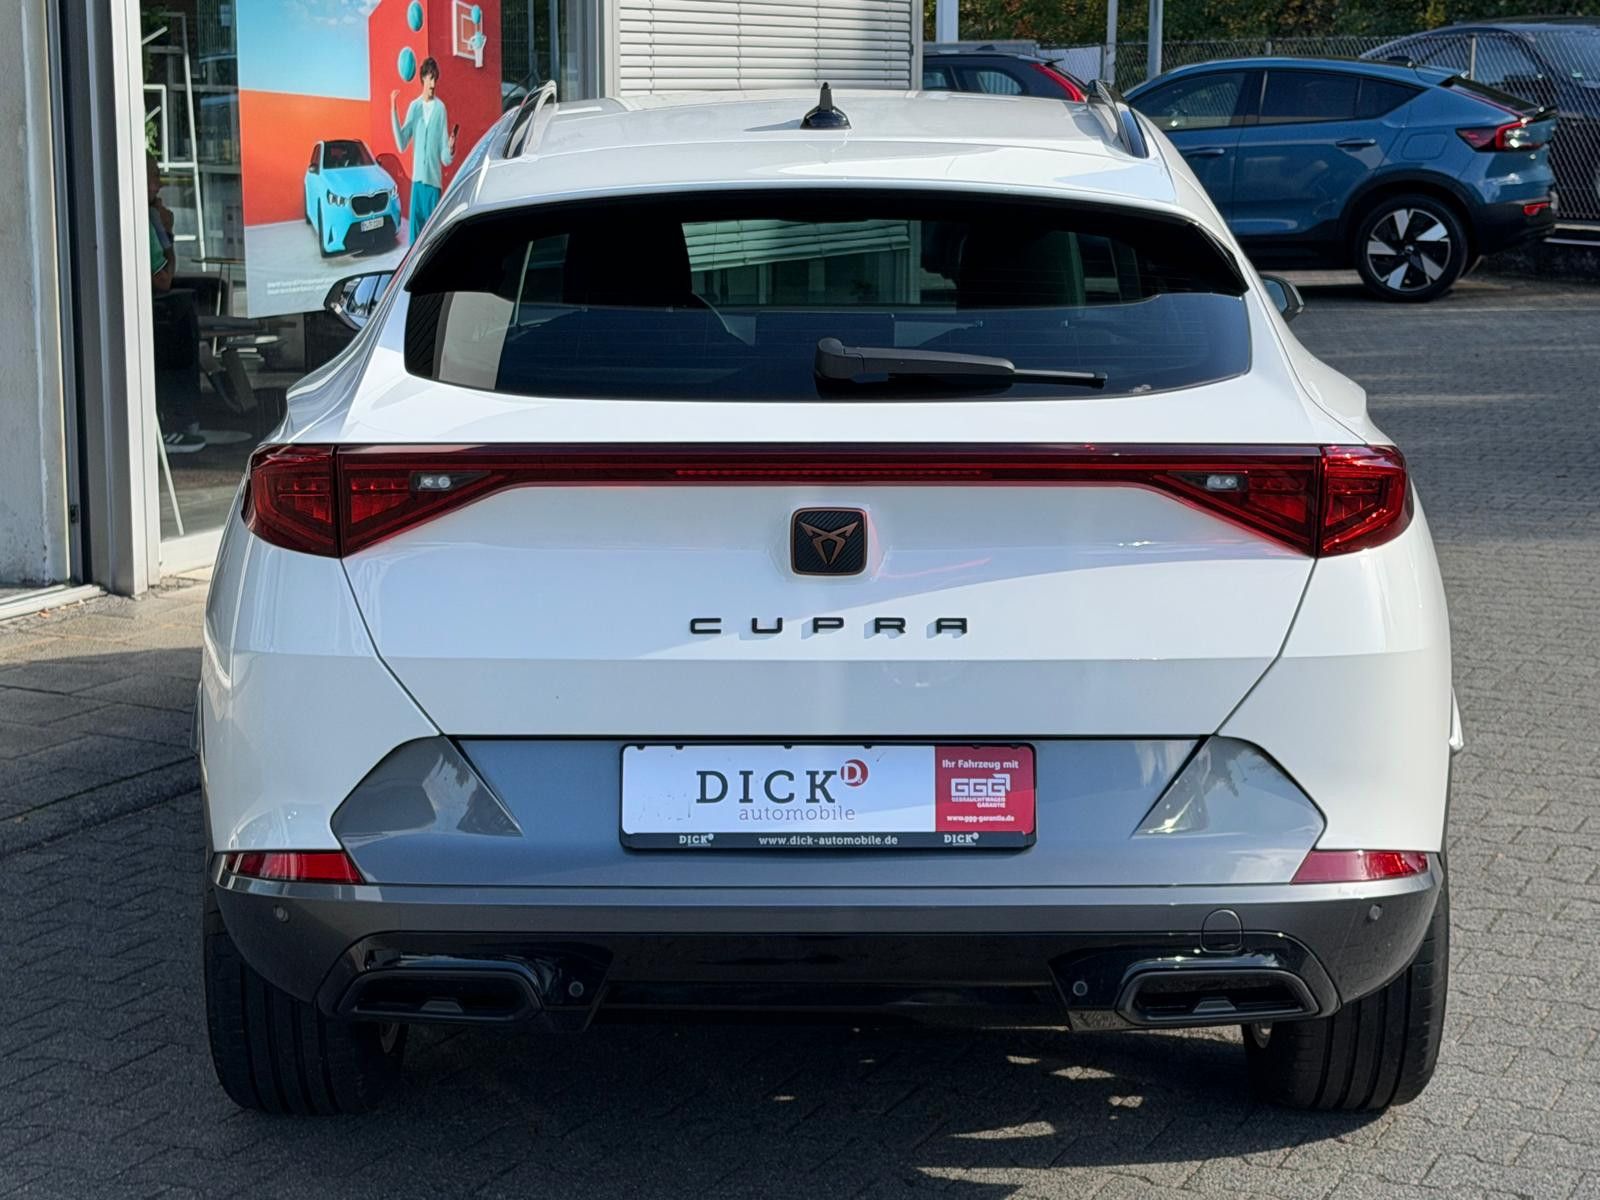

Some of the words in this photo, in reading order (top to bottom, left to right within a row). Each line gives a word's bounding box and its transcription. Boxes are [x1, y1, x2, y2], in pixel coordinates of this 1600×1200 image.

[690, 617, 968, 634] CUPRA
[942, 759, 956, 769] Ihr
[958, 759, 1001, 771] Fahrzeug
[1003, 759, 1019, 769] mit
[696, 770, 837, 804] DICK
[951, 778, 1006, 796] GGG
[739, 805, 855, 821] automobile
[946, 815, 1015, 823] www.ggg-garantie.de
[679, 834, 709, 844] DICK
[758, 835, 898, 846] www.dick-automobile.de
[944, 834, 973, 844] DICK
